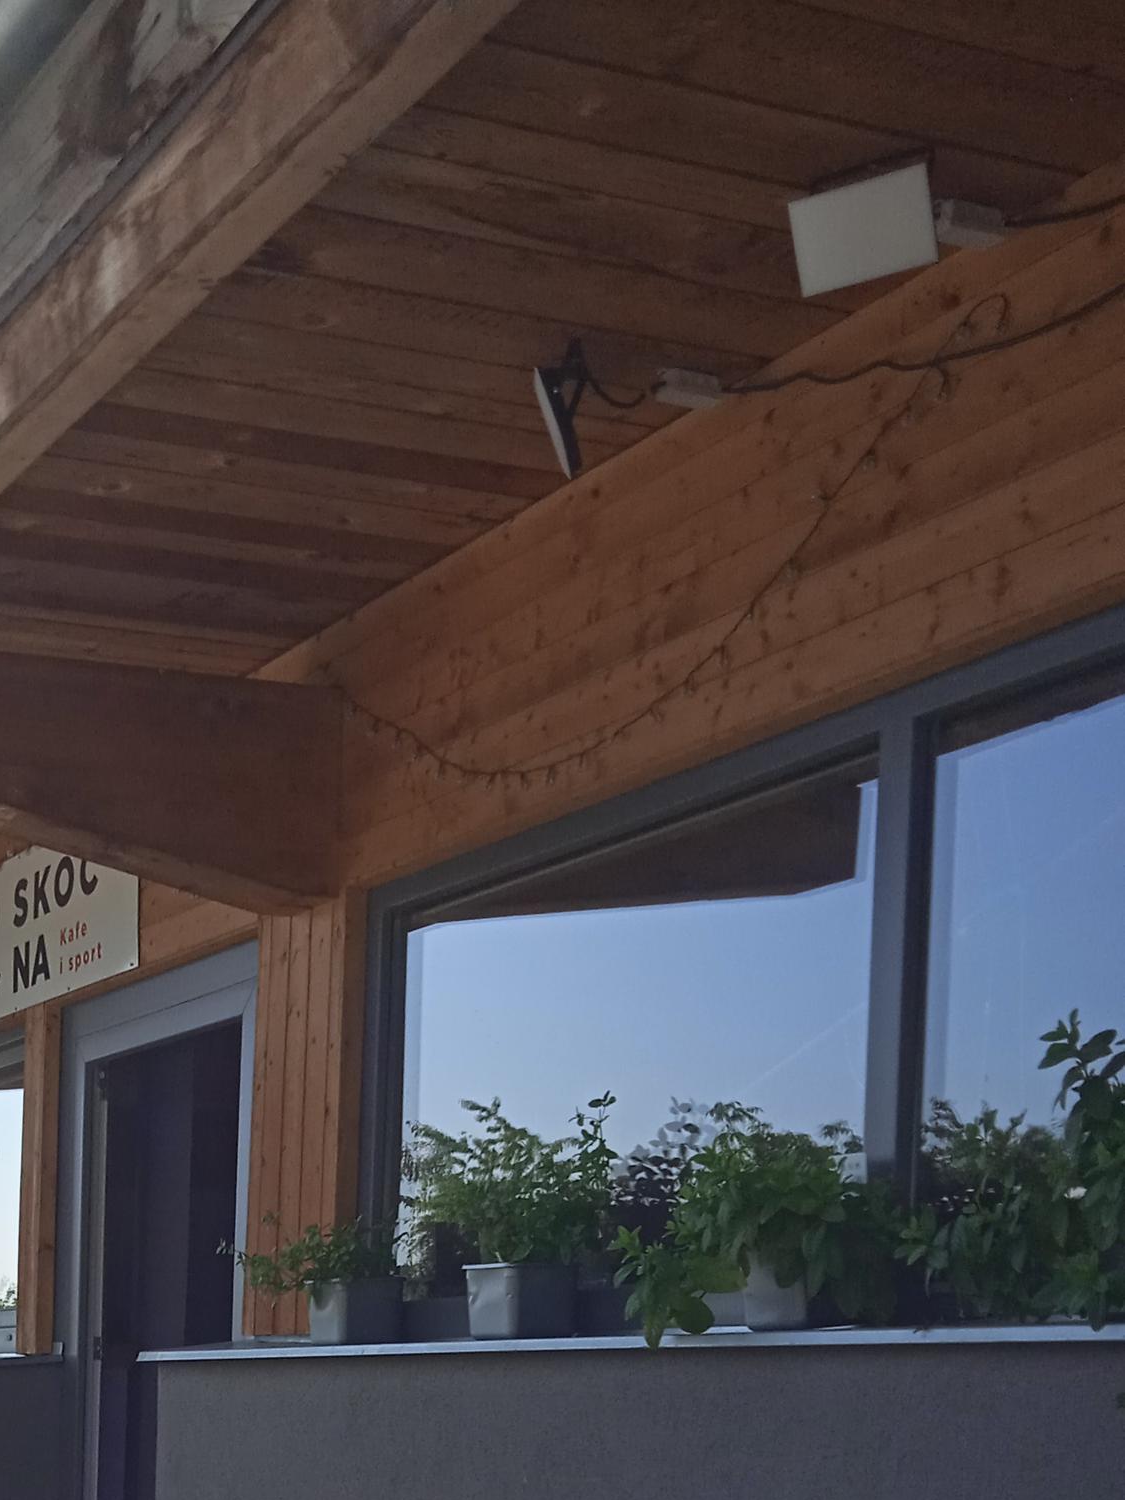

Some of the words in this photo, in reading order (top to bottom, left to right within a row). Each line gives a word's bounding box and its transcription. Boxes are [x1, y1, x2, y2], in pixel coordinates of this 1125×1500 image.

[59, 921, 87, 946] Kafe
[12, 933, 50, 994] NA
[68, 942, 101, 972] sport
